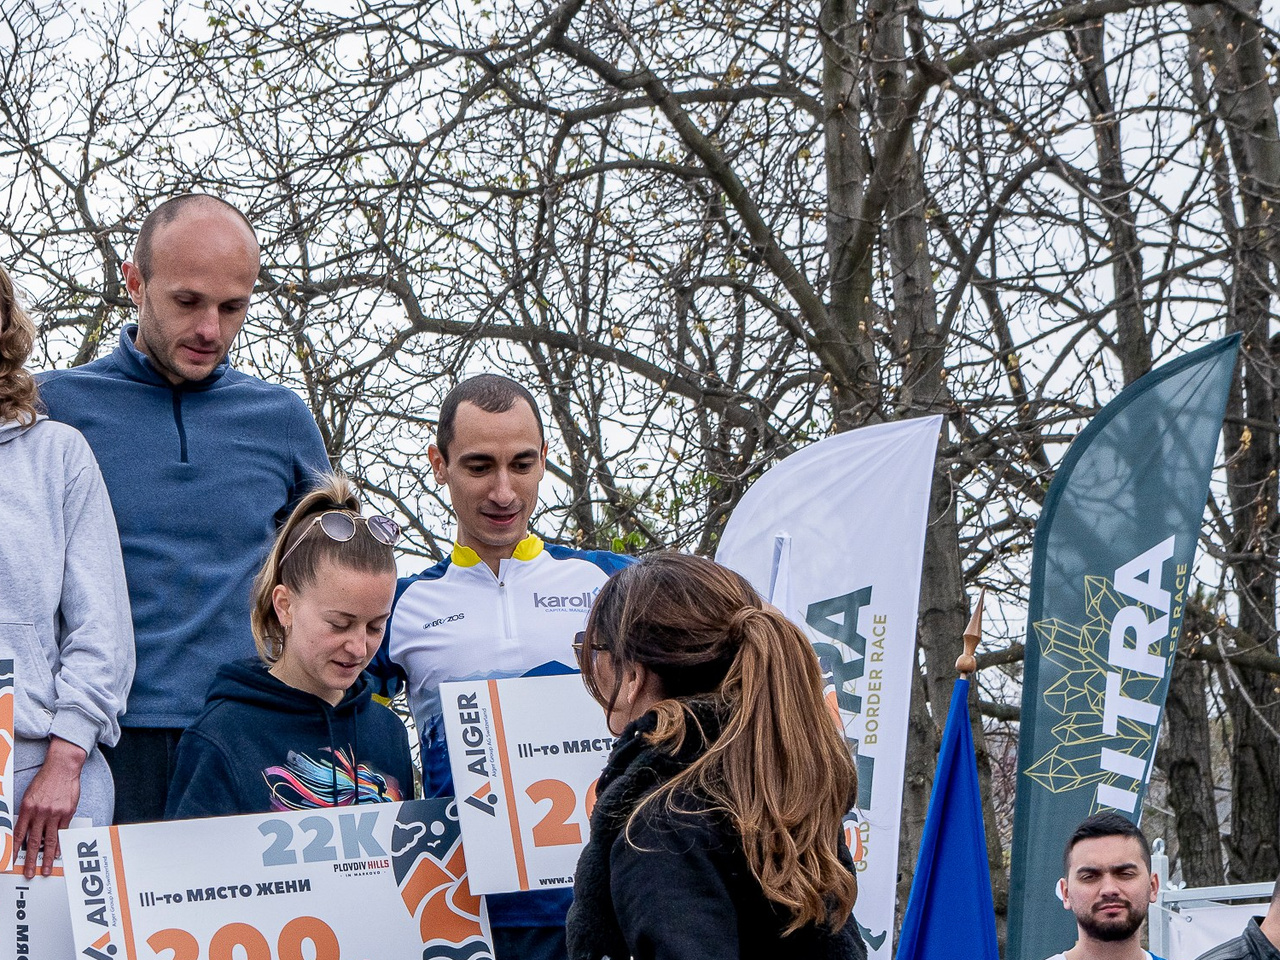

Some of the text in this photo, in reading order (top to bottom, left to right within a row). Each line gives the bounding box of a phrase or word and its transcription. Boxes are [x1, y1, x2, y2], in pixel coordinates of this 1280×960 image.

[1173, 563, 1187, 619] RACE
[864, 614, 887, 745] BORDER RACE
[457, 692, 489, 778] AIGER
[258, 811, 387, 867] 22K
[333, 859, 389, 873] PLOVDIV HILLS
[77, 840, 109, 927] AIGER
[186, 884, 252, 902] МЯСТО
[256, 878, 311, 897] ЖЕНИ
